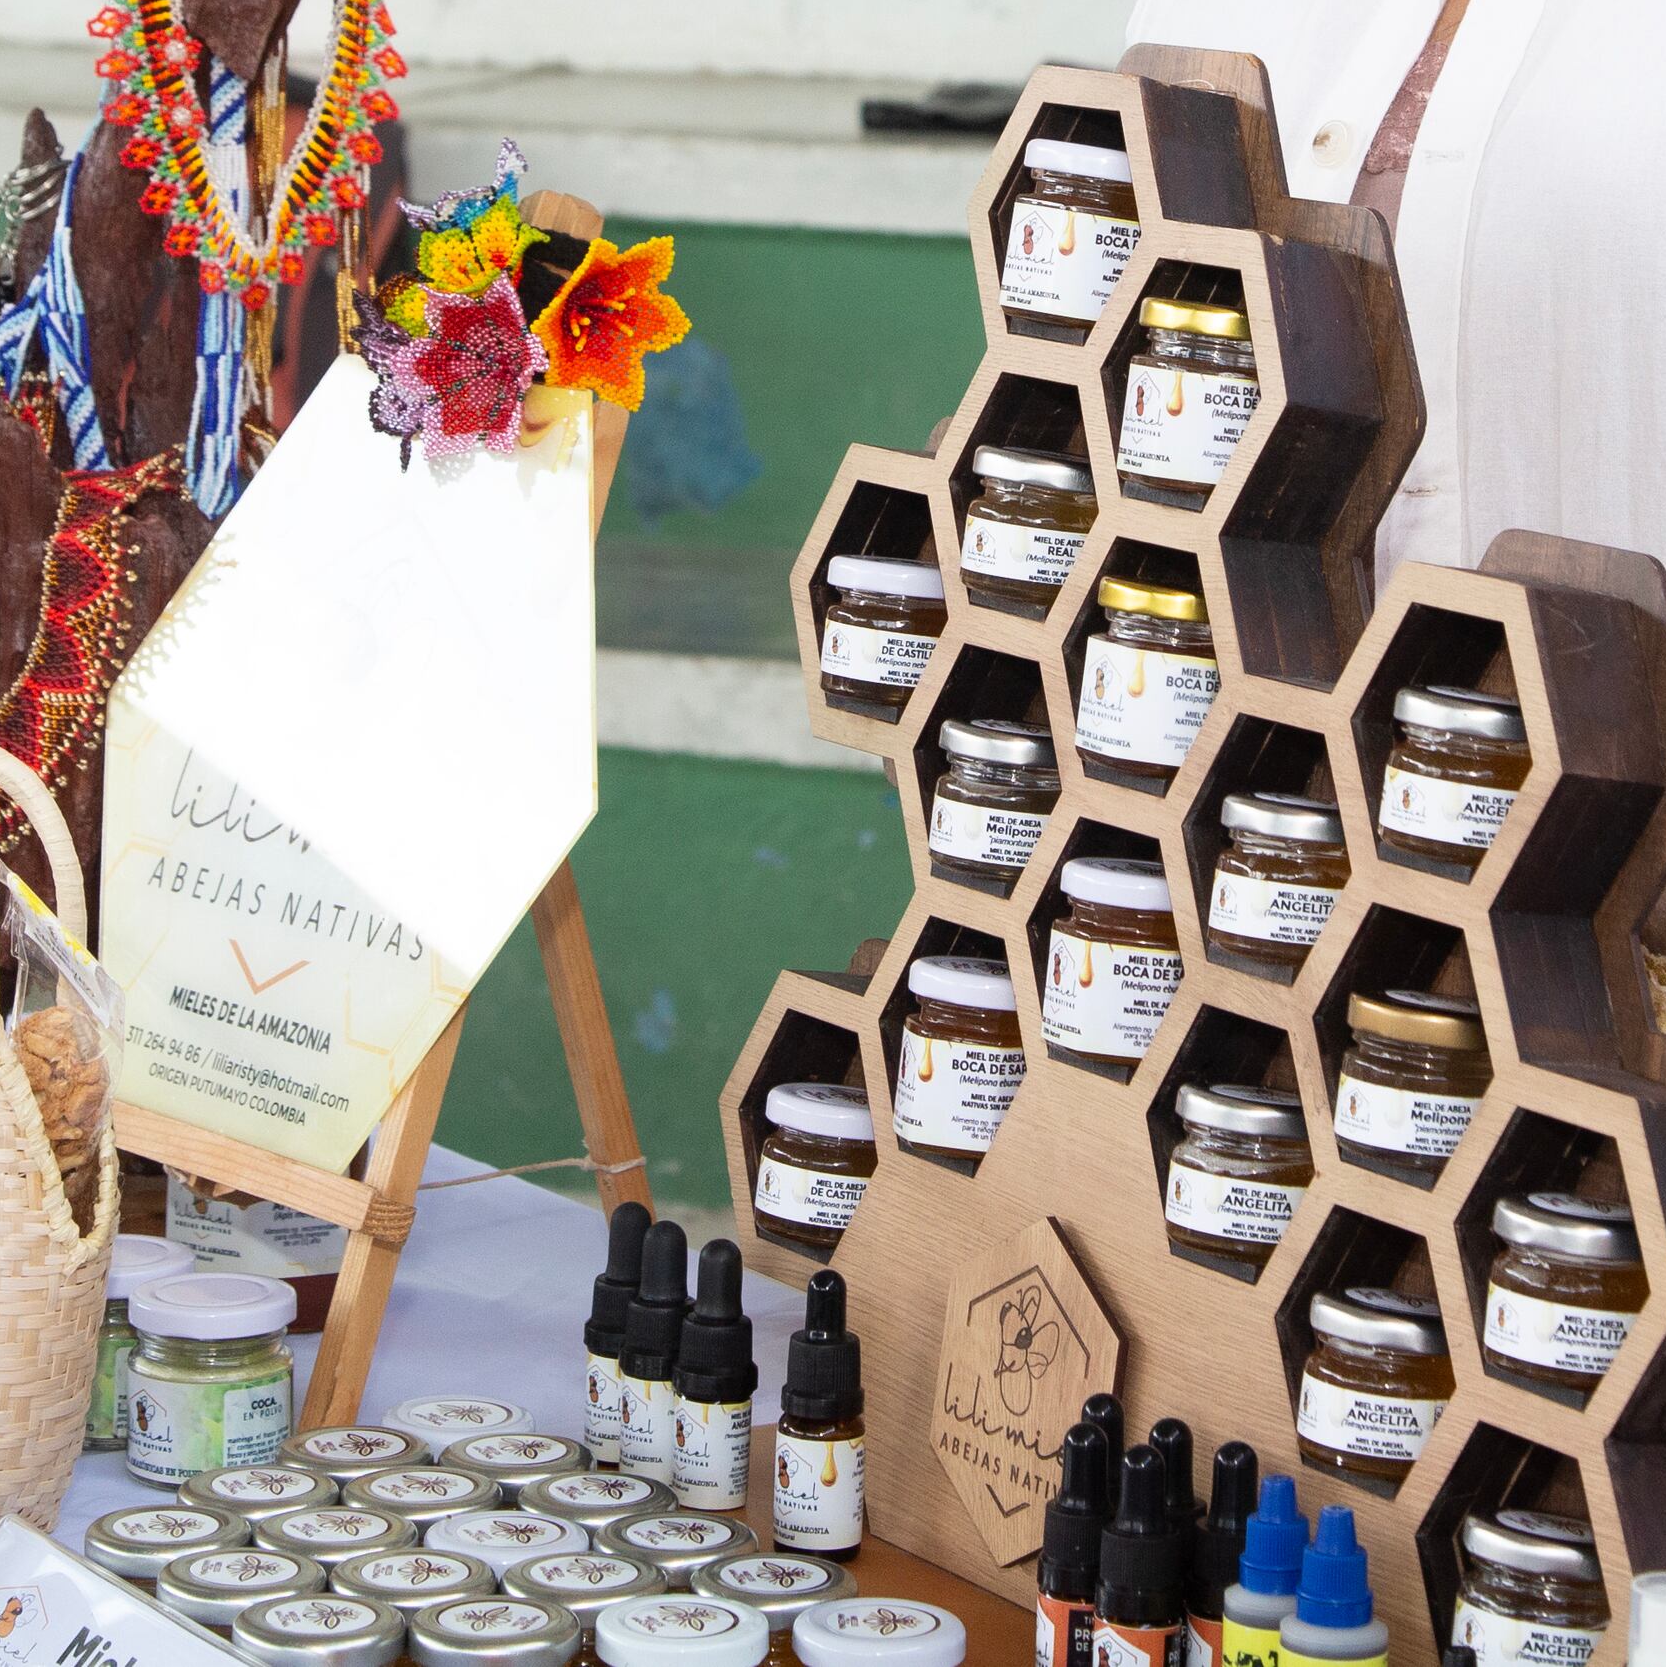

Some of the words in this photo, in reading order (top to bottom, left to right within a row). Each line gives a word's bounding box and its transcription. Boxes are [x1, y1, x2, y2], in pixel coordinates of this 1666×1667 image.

[1111, 226, 1130, 238] MIEL
[1096, 235, 1129, 249] BOCA
[1220, 385, 1240, 396] MIEL
[1204, 393, 1241, 408] BOCA
[1034, 535, 1053, 545] MIEL
[1054, 537, 1065, 546] DE
[1048, 546, 1075, 558] REAL
[887, 638, 905, 647] MIEL
[906, 640, 916, 649] DE
[882, 646, 894, 657] DE
[1182, 667, 1203, 679] MIEL
[1205, 670, 1217, 680] DE
[1166, 676, 1202, 692] BOCA
[1472, 794, 1491, 805] MIEL
[989, 815, 1006, 825] MIEL
[1008, 817, 1017, 825] DE
[1278, 891, 1296, 900] MIEL
[1298, 893, 1309, 902] DE
[148, 855, 267, 916] ABEJAS
[280, 892, 425, 962] NATIVAS
[1129, 955, 1147, 966] MIEL
[1149, 957, 1161, 967] DE
[1113, 964, 1150, 979] BOCA
[1153, 967, 1170, 980] DE
[1121, 979, 1161, 993] (Melipona
[169, 986, 216, 1018] MIELES
[217, 1000, 238, 1025] DE
[238, 1006, 254, 1032] LA
[255, 1013, 332, 1055] AMAZONIA
[966, 1050, 986, 1061] MIEL
[988, 1052, 1000, 1062] DE
[126, 1026, 143, 1043] 311
[144, 1031, 166, 1051] 264
[167, 1040, 183, 1058] 94
[185, 1045, 201, 1063] 86
[211, 1053, 349, 1113] liliaristy@hotmail.com
[952, 1060, 986, 1074] BOCA
[990, 1062, 1006, 1075] DE
[959, 1074, 997, 1087] (Melipona
[149, 1063, 190, 1089] ORIGEN
[189, 1077, 248, 1107] PUTUMAYO
[249, 1095, 306, 1126] COLOMBIA
[1414, 1100, 1431, 1111] MIEL
[816, 1178, 833, 1189] MIEL
[835, 1181, 845, 1190] DE
[811, 1187, 825, 1198] DE
[1232, 1187, 1249, 1197] MIEL
[1251, 1189, 1262, 1199] DE
[1264, 1190, 1288, 1202] ABEJA
[804, 1196, 839, 1208] (Melipona
[1224, 1194, 1293, 1213] ANGELITA
[1565, 1314, 1584, 1325] MIEL
[1586, 1317, 1597, 1327] DE
[251, 1397, 277, 1410] COCA
[1355, 1400, 1373, 1411] MIEL
[1375, 1402, 1386, 1412] DE
[1388, 1404, 1413, 1415] ABEJA
[243, 1412, 254, 1421] EN
[1347, 1408, 1419, 1428] ANGELITA
[940, 1432, 1000, 1475] ABEJAS
[165, 1465, 176, 1475] EN
[784, 1500, 818, 1511] NATIVAS
[789, 1522, 829, 1535] AMAZONIA
[1532, 1632, 1550, 1643] MIEL
[1553, 1635, 1564, 1644] DE
[1566, 1636, 1591, 1646] ABEJA
